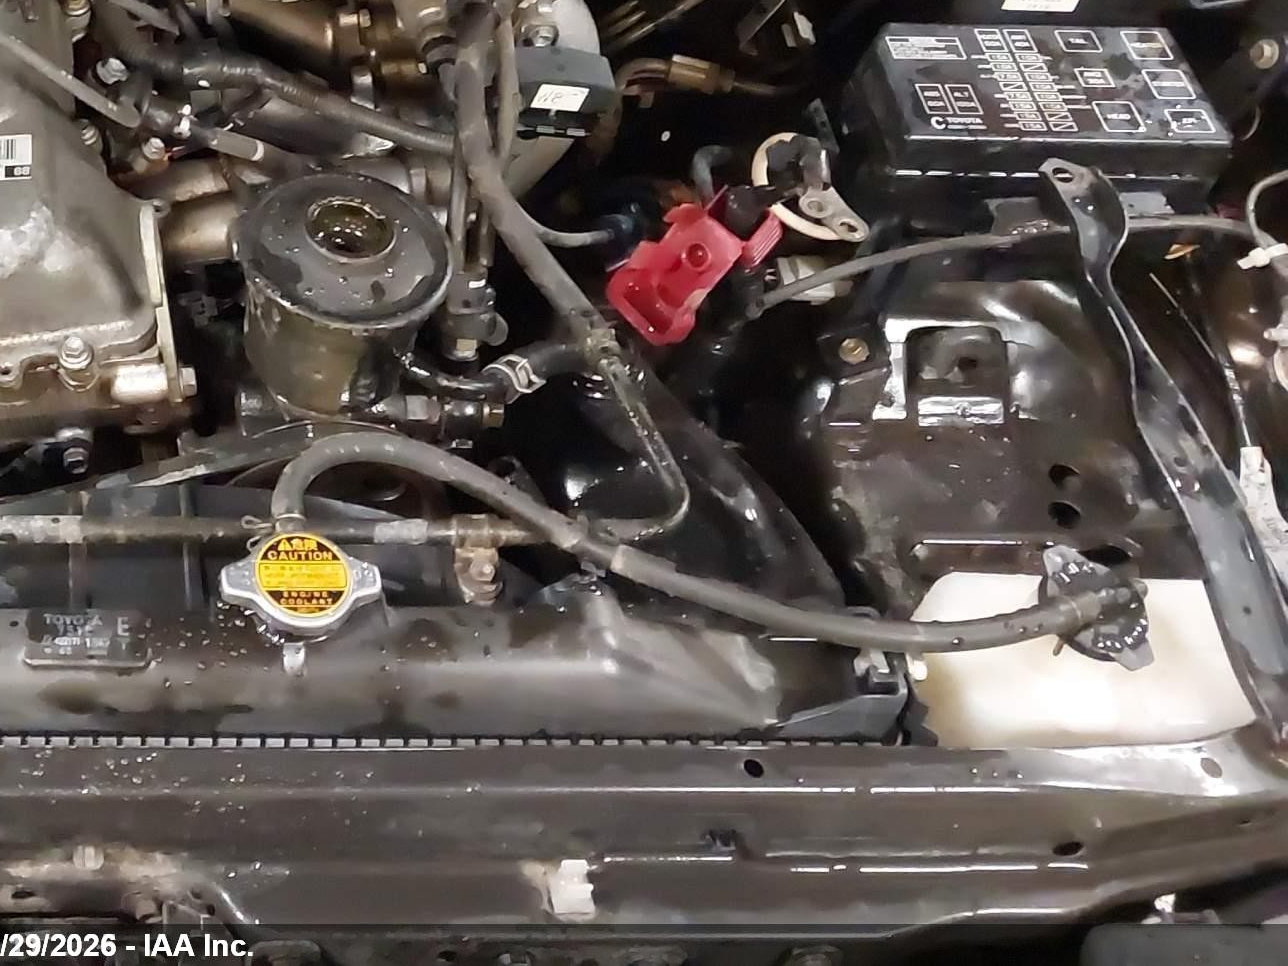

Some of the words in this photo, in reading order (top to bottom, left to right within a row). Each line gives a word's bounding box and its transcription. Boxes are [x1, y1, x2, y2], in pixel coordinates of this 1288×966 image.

[267, 550, 333, 561] CAUTION
[43, 613, 103, 626] TOYOTA
[117, 616, 130, 636] E
